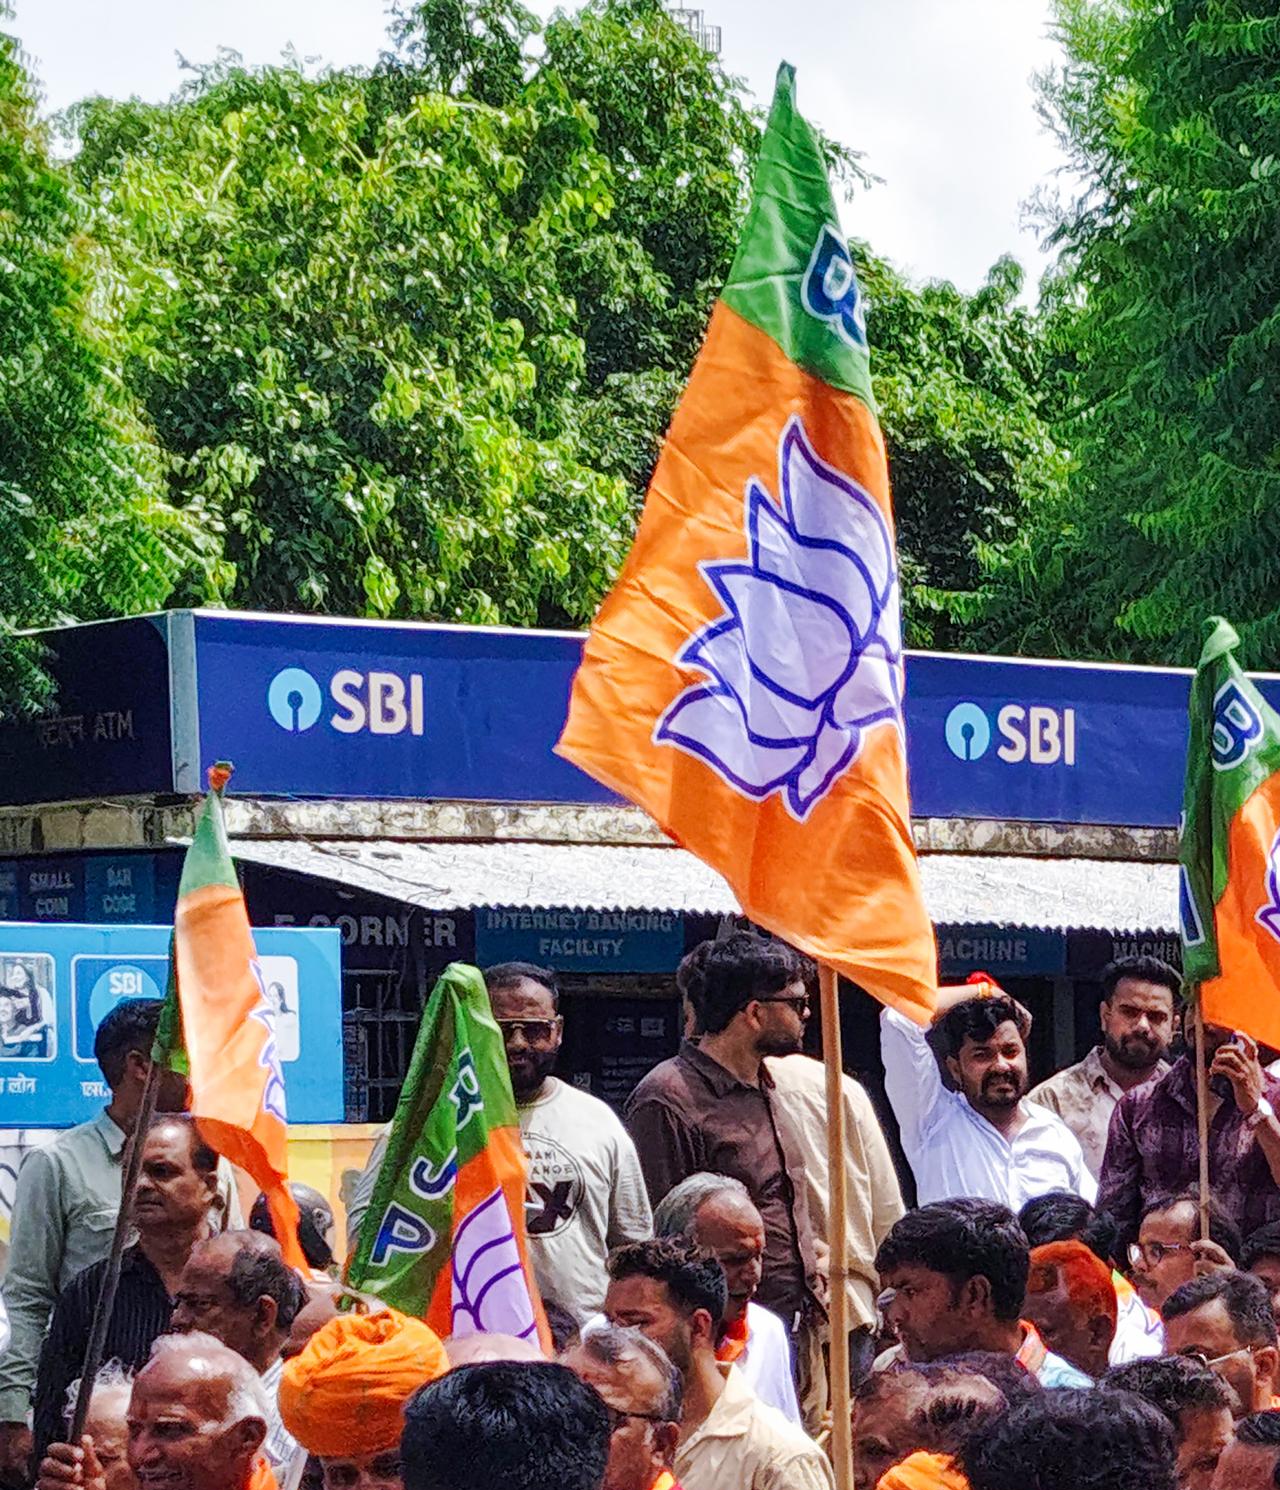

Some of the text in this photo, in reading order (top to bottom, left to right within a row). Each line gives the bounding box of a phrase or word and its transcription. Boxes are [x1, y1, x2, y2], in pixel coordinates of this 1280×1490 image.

[329, 670, 425, 736] SBI
[95, 710, 136, 742] ATM
[996, 706, 1076, 766] SBI
[539, 938, 624, 958] FACILITY
[939, 937, 1027, 962] ACHINE
[109, 972, 143, 994] SBI
